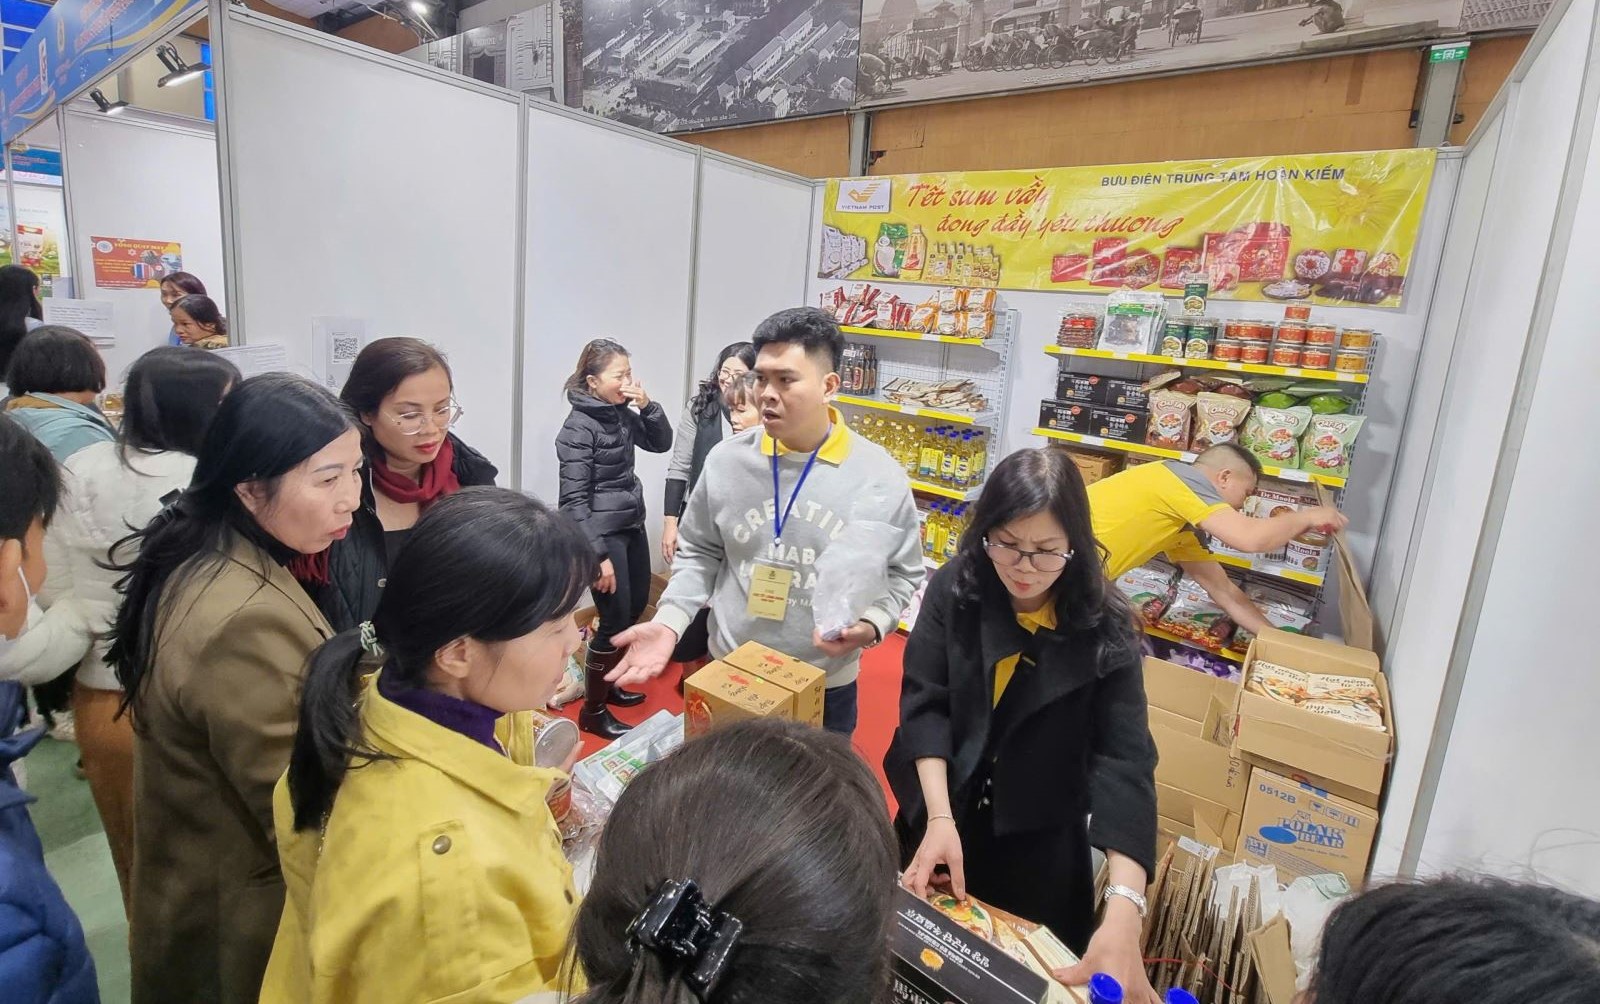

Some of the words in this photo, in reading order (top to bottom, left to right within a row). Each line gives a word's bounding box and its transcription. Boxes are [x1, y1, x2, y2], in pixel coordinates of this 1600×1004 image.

[1166, 172, 1215, 184] TRUNG
[1304, 164, 1345, 180] KIẾM
[908, 180, 947, 207] Tết
[948, 189, 1000, 207] sum
[733, 498, 846, 544] CREATIV
[1259, 784, 1297, 804] 0512B
[1278, 818, 1343, 841] POLAR
[1298, 830, 1344, 849] BEAR
